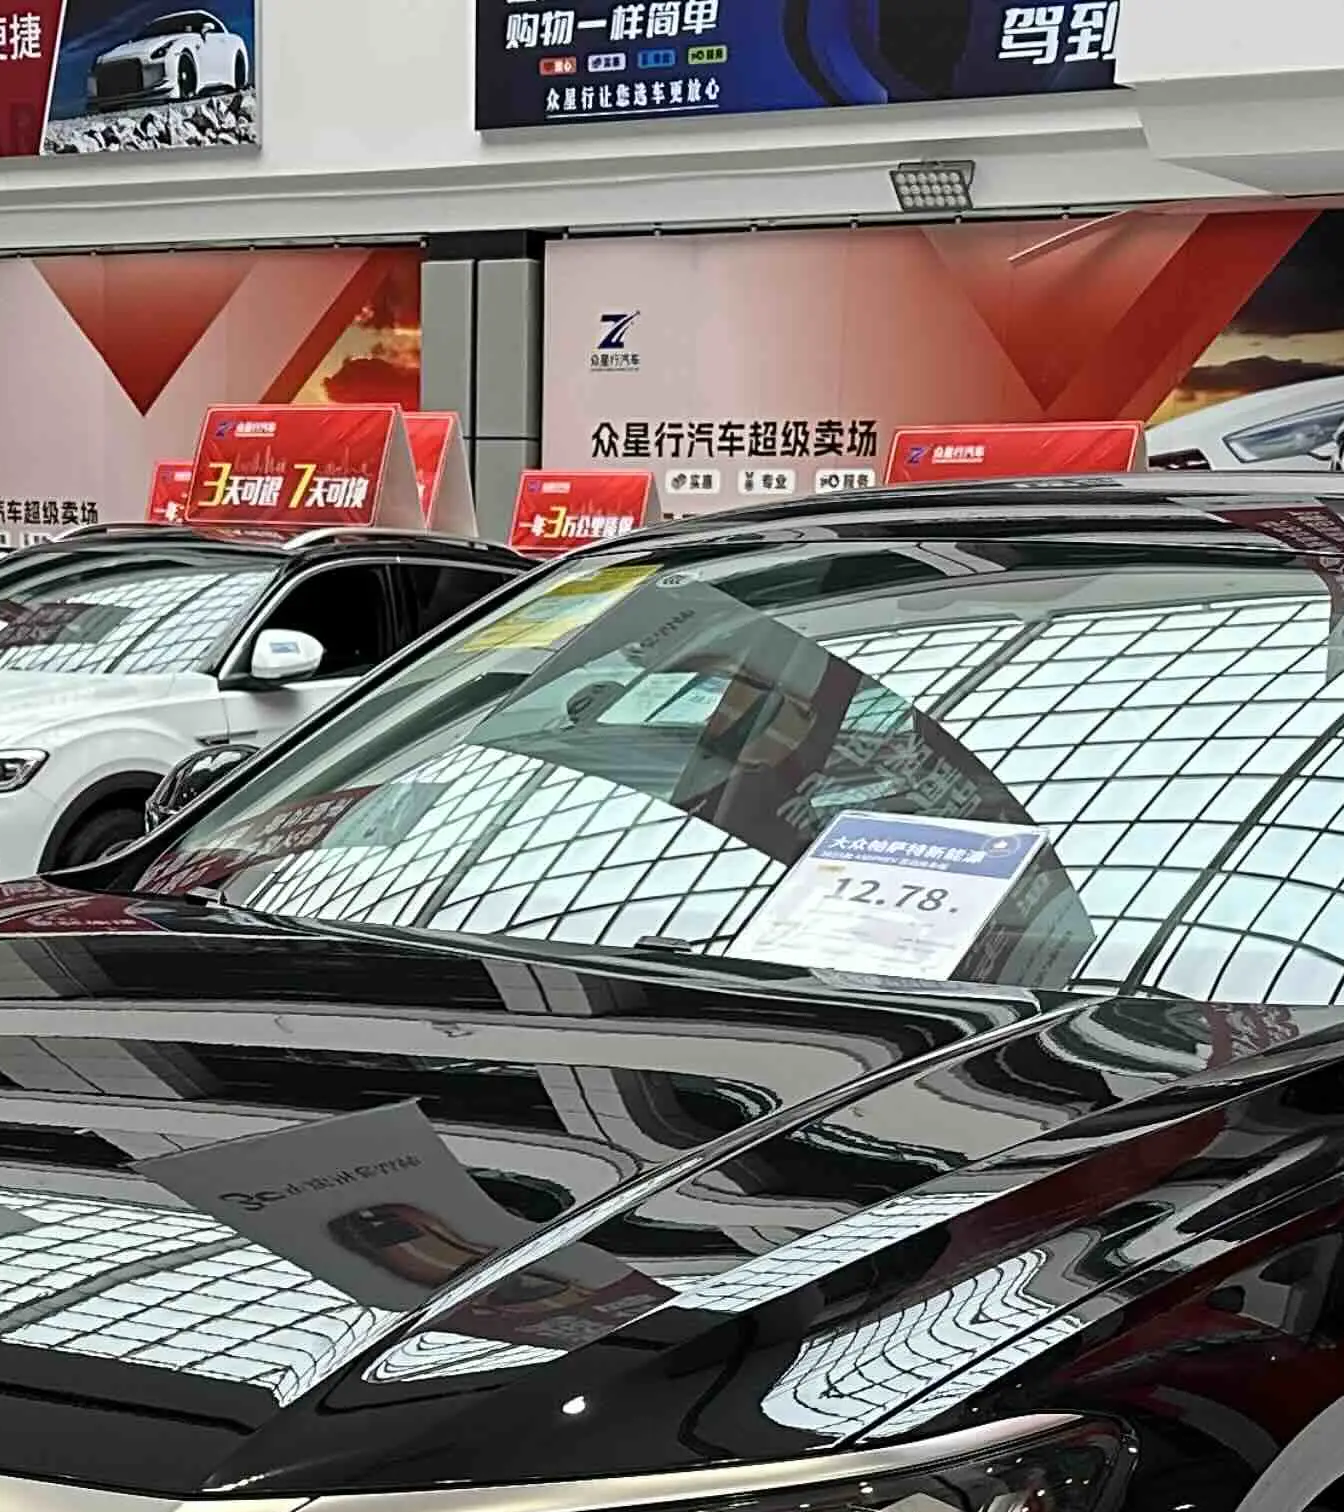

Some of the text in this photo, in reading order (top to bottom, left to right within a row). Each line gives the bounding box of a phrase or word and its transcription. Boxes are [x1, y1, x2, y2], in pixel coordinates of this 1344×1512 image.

[506, 0, 719, 49] 购物一样简单
[999, 2, 1119, 64] 驾到
[545, 77, 721, 113] 众星行让您选车更放心
[592, 420, 877, 458] 众星行汽车超级卖场
[198, 463, 369, 509] 3天可退 7天可换
